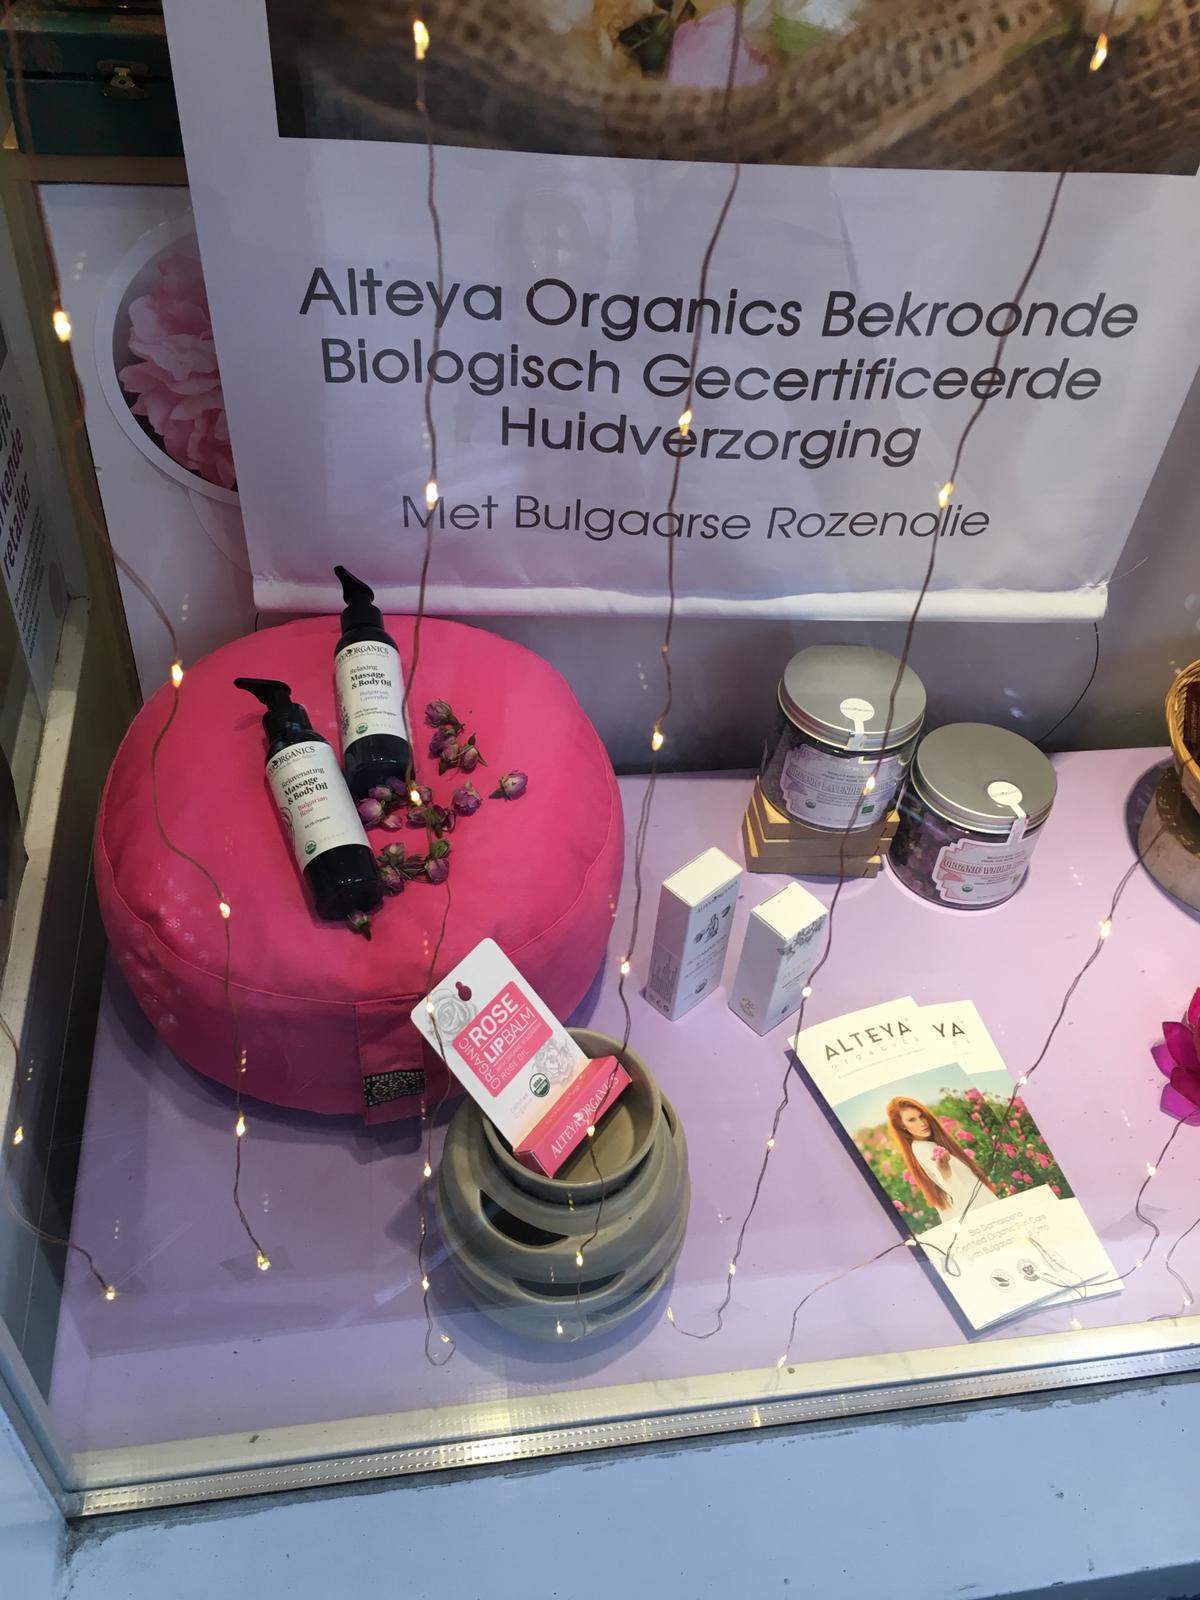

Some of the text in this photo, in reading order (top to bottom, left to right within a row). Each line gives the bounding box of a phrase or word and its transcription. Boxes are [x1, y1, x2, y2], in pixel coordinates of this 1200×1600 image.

[299, 267, 1138, 342] Alteya Organics Bekroonde
[321, 338, 1101, 401] Biologisch Gecertificeerde
[501, 406, 921, 469] Huidverzorging
[0, 427, 24, 536] rkende
[3, 471, 31, 580] retailer
[402, 495, 989, 541] Met Bulgaarse Rozenolie
[350, 665, 378, 674] Relaxing
[351, 672, 385, 681] Massage
[358, 678, 380, 687] Body
[282, 767, 325, 788] Rejuvenating
[284, 777, 319, 797] Massage
[287, 782, 328, 805] & Body Oil
[944, 858, 982, 875] ORGANIC
[468, 992, 518, 1048] ROSE
[825, 1021, 912, 1060] ALTEYA
[458, 1037, 501, 1089] ORGANIC
[550, 1119, 583, 1159] ALTEYA
